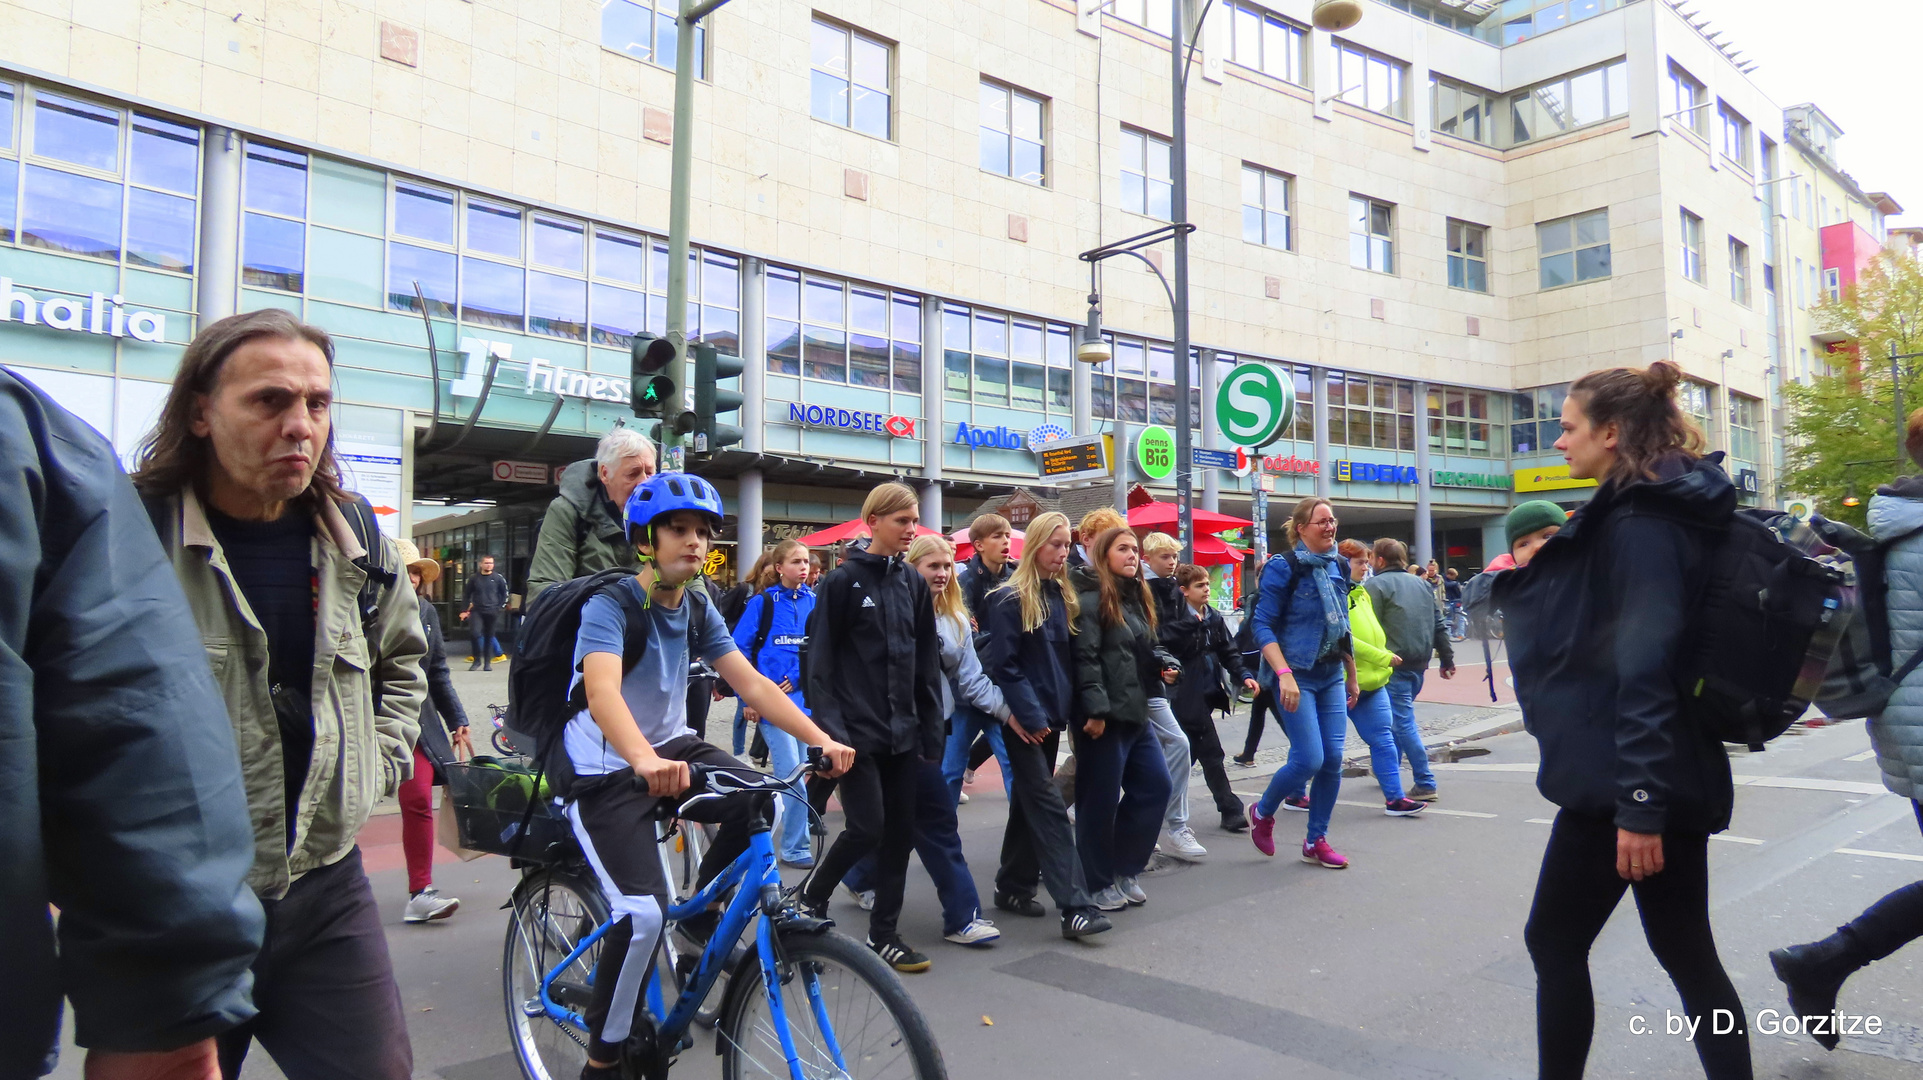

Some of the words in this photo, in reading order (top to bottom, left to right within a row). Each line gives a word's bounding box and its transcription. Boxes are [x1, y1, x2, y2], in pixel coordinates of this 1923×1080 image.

[0, 276, 165, 343] halia
[790, 402, 883, 431] NORDSEE
[1228, 373, 1272, 436] S
[954, 421, 1021, 450] Apollo
[1146, 438, 1169, 447] Denns
[1264, 453, 1320, 474] odafone
[1350, 462, 1419, 484] EDEKA
[772, 523, 817, 540] Tchib
